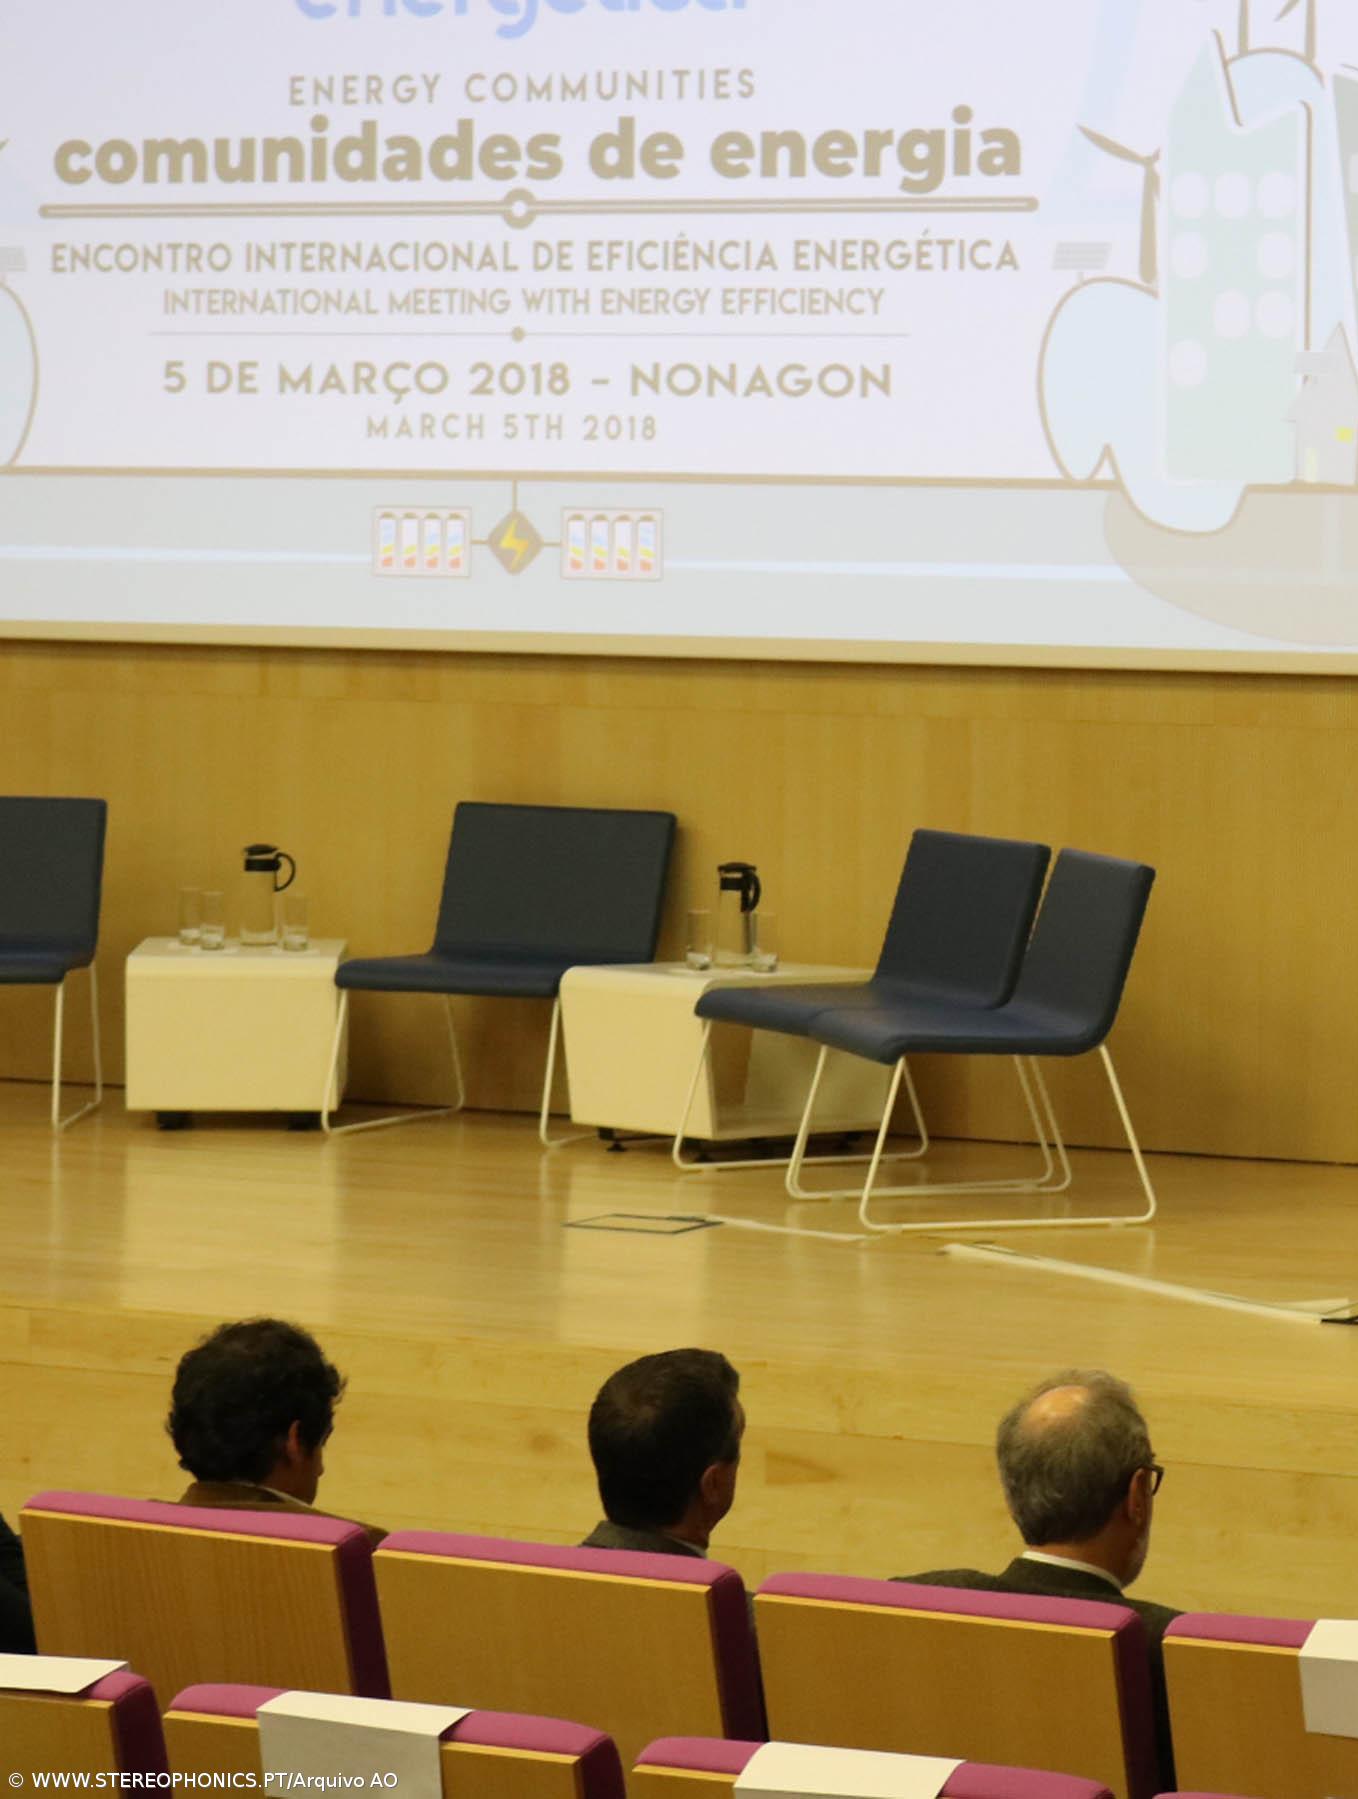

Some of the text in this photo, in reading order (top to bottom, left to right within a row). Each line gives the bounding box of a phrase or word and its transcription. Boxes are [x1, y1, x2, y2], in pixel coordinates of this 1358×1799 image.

[288, 68, 756, 106] ENERGY COMMUNITIES
[52, 104, 1023, 195] comunidades de energia
[50, 229, 1020, 274] ENCONTRO INTERNACIONAL DE EFICIÊNCIA ENERGÉTICA
[163, 287, 885, 316] INTERNATIONAL MEETING WITH ENERGY EFFICIENCY
[163, 360, 188, 395] 5
[206, 360, 260, 395] DE
[278, 360, 451, 405] MARÇO
[468, 361, 572, 396] 2018
[630, 361, 892, 398] NONAGON
[366, 412, 657, 441] MARCH 5TH 2018
